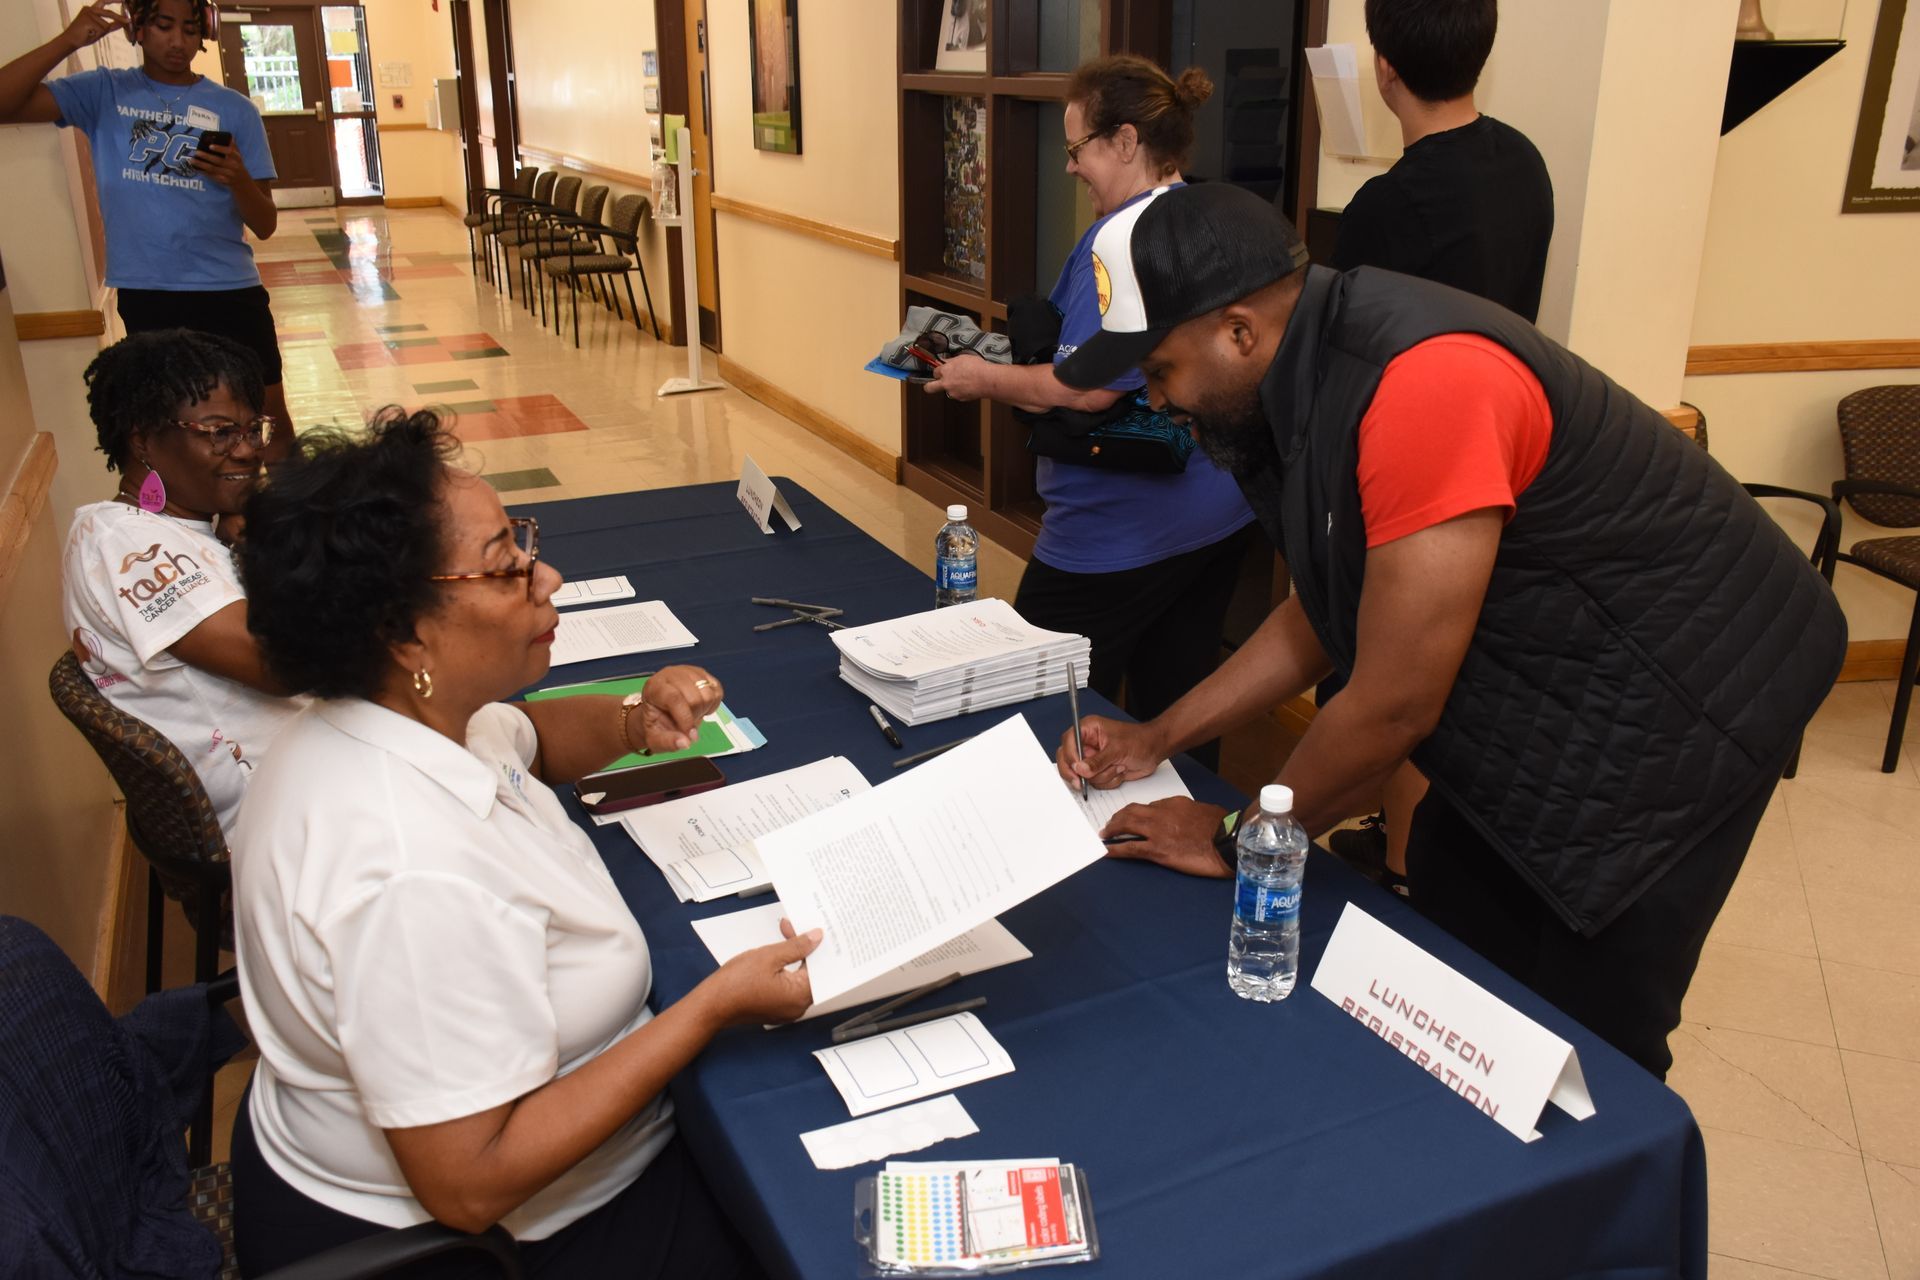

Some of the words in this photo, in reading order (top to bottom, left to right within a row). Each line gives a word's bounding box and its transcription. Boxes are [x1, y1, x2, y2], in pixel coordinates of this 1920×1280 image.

[122, 168, 150, 182] HIGH
[151, 172, 206, 191] SCHOOL
[139, 603, 156, 617] THE
[155, 584, 179, 605] BLACK
[178, 570, 205, 587] BREAST
[144, 596, 177, 623] CANCER
[176, 575, 211, 598] ALLIANCE
[1368, 978, 1495, 1077] LUNCHEON
[1341, 996, 1499, 1119] REGISTRATION
